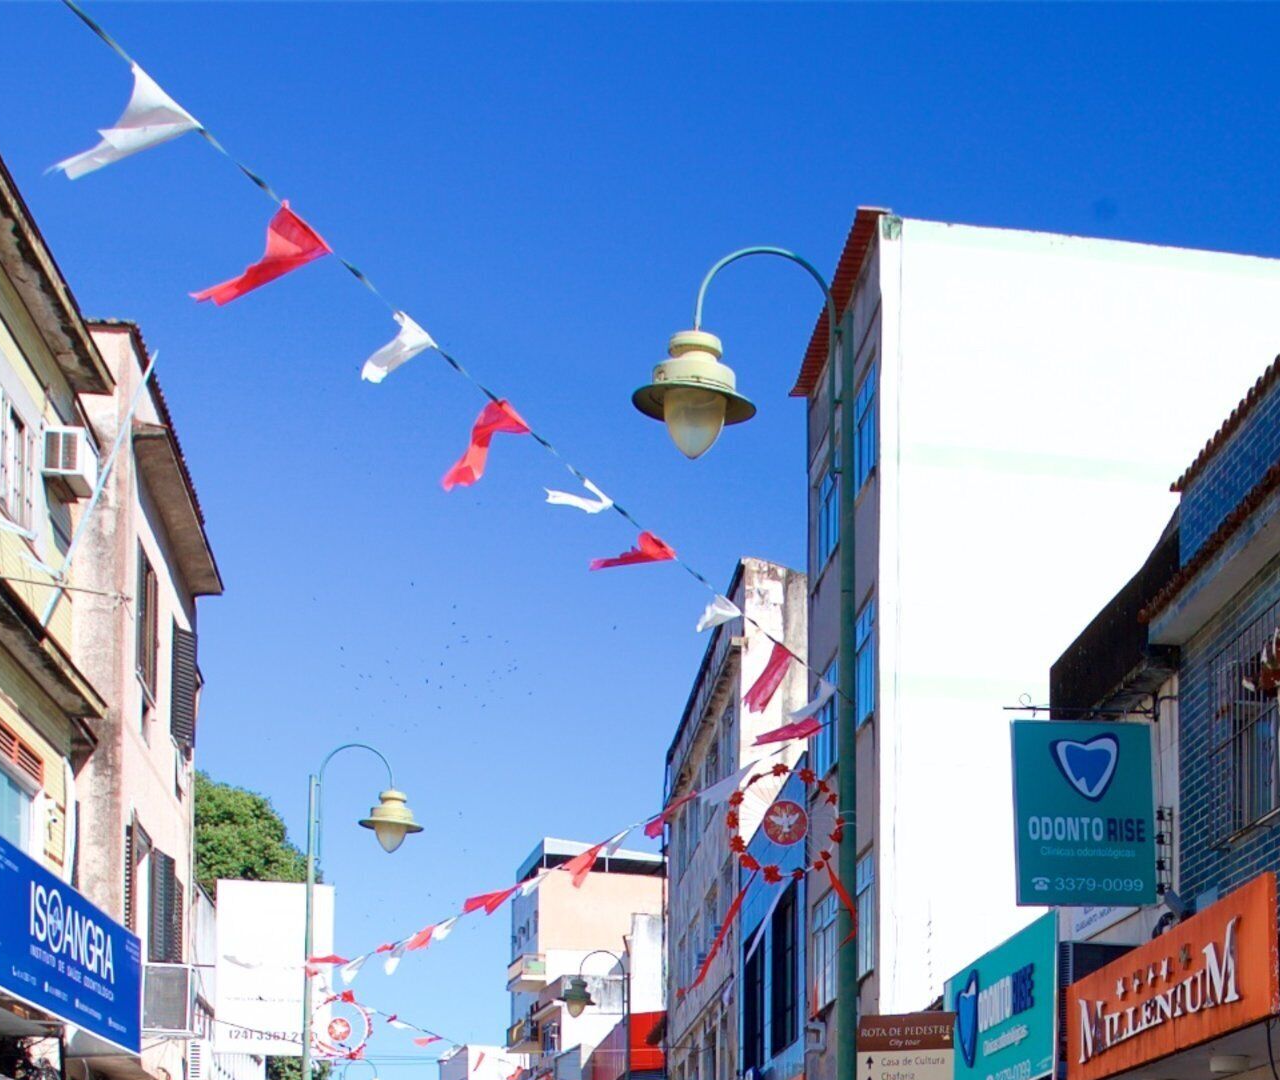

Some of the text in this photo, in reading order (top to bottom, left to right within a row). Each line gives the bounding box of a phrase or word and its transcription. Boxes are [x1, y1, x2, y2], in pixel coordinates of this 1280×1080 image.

[1055, 878, 1144, 892] 3379-0099
[30, 880, 115, 985] ISOANGRA
[1078, 916, 1240, 1065] MILLENIUM
[861, 1025, 950, 1037] ROTA DE PEDESTRE
[889, 1039, 904, 1048] City
[881, 1056, 945, 1067] Casa de Cultura
[881, 1072, 915, 1080] Chafariz
